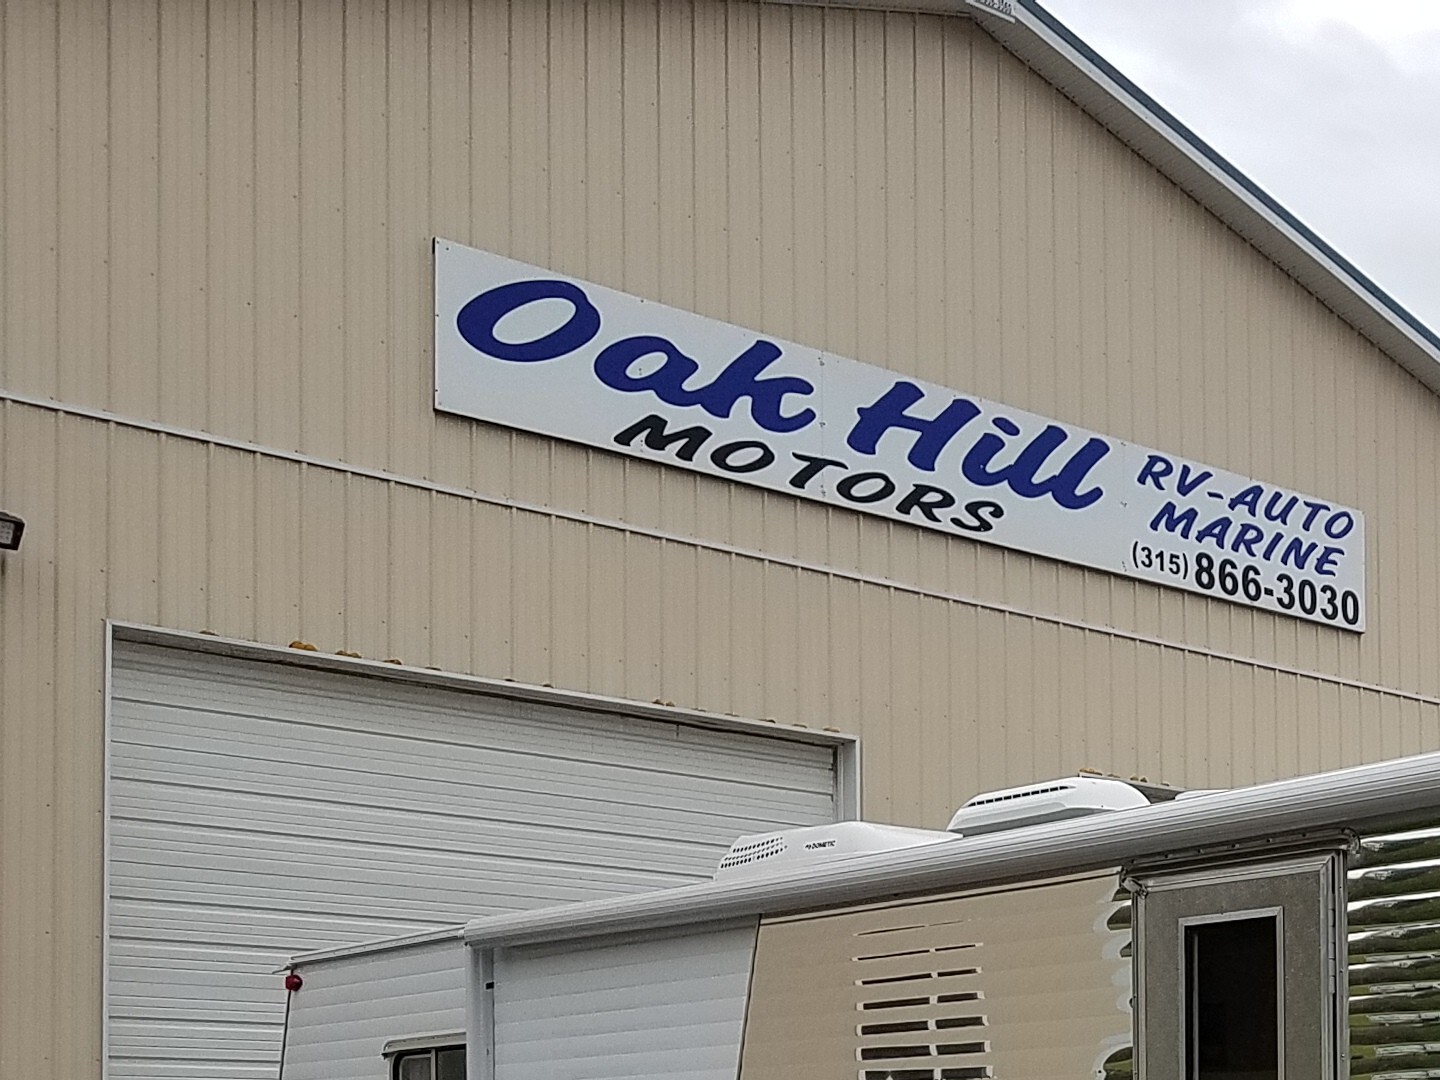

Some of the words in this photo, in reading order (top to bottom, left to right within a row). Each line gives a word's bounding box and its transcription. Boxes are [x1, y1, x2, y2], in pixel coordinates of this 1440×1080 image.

[456, 280, 815, 433] Oak
[846, 381, 1112, 510] Hill
[613, 414, 1005, 533] MOTORS
[1136, 455, 1354, 540] RV-AUTO
[1150, 501, 1345, 577] MARINE
[1131, 541, 1189, 580] (315)
[1195, 552, 1359, 626] 866-3030
